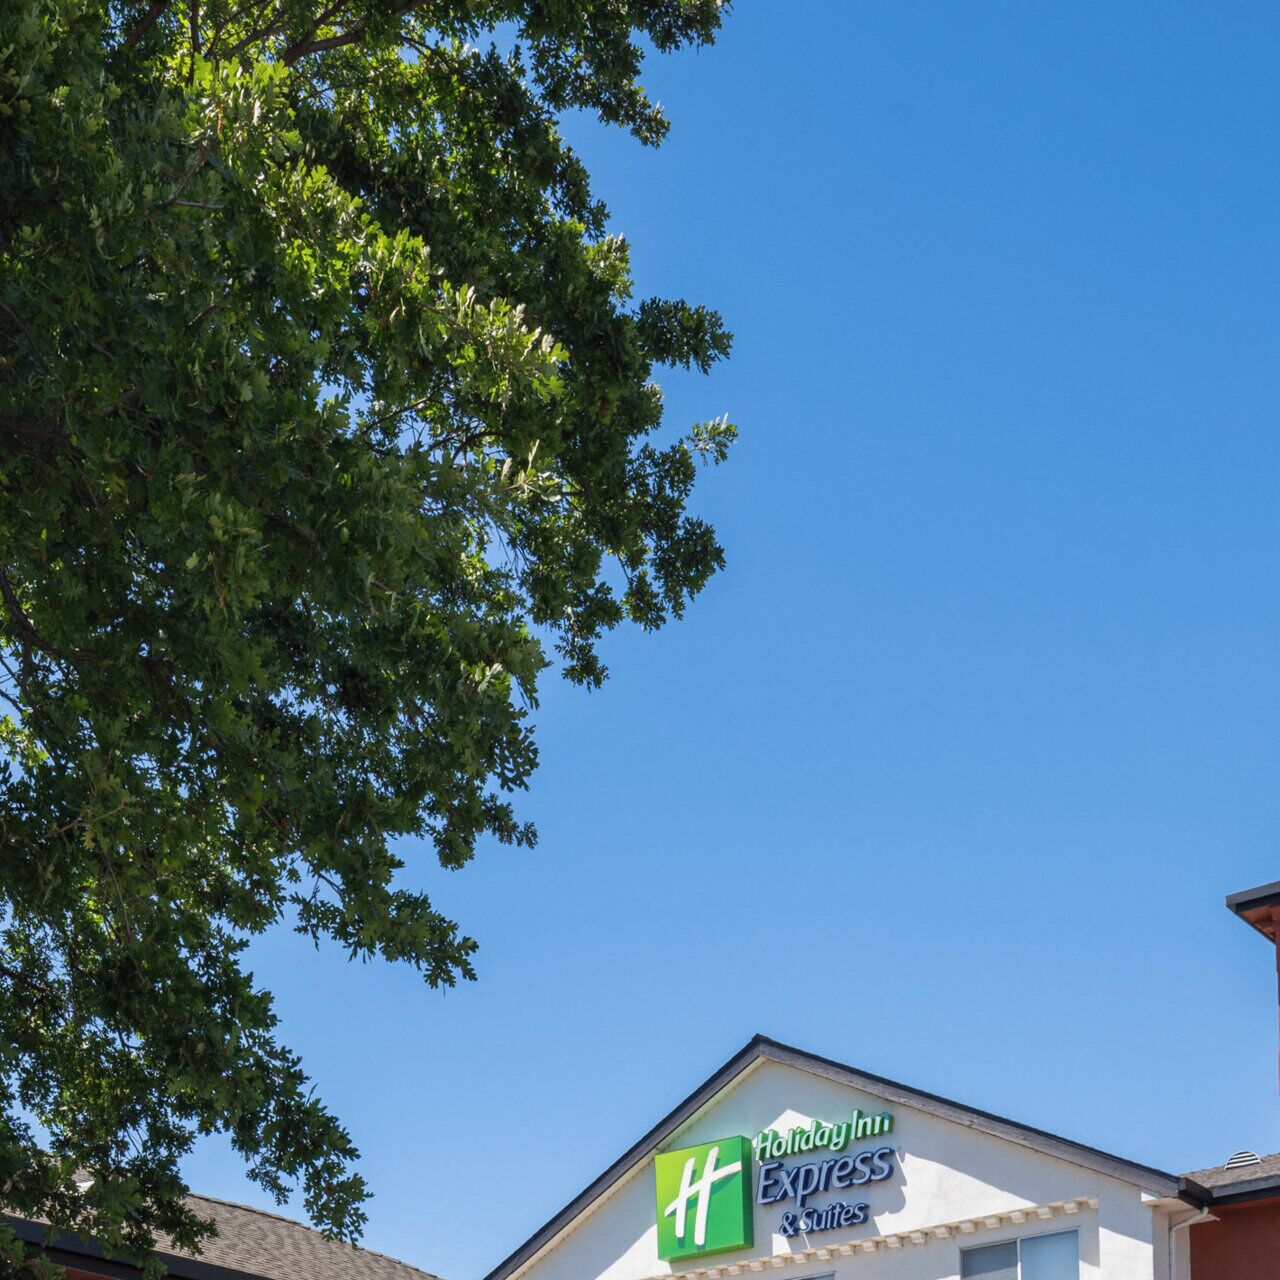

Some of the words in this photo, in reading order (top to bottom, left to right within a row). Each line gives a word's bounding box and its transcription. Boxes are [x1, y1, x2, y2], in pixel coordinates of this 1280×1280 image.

[754, 1120, 851, 1160] Holiday
[851, 1109, 894, 1140] Inn
[757, 1147, 894, 1208] Express
[780, 1212, 800, 1237] &
[799, 1202, 869, 1233] Suites
